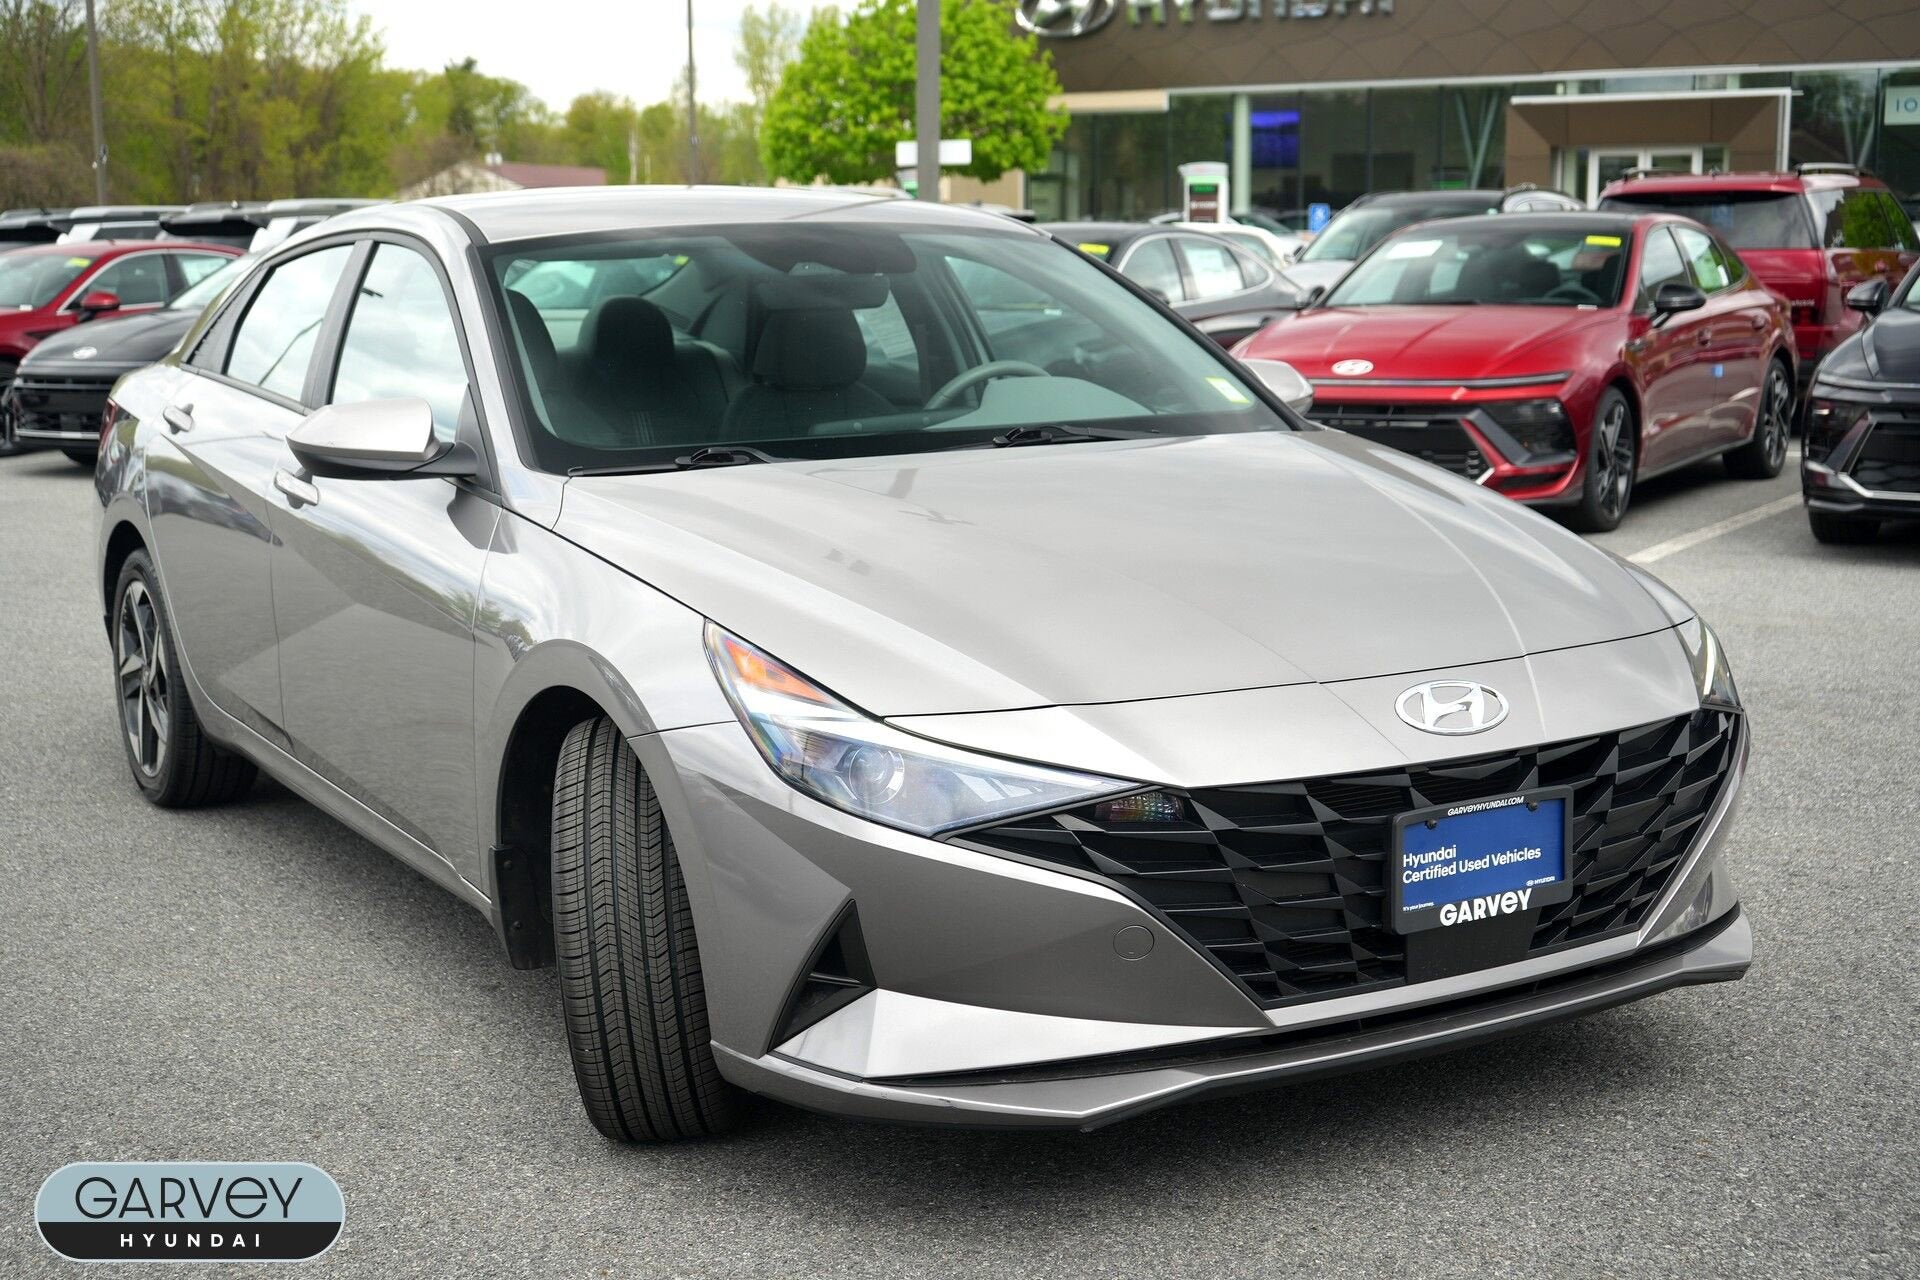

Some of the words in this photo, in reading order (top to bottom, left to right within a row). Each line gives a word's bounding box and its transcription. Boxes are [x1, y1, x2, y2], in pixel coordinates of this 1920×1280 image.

[1402, 861, 1457, 884] Certified
[1459, 854, 1490, 873] Used
[1491, 847, 1541, 866] Vehicles
[1403, 845, 1457, 868] Hyundai
